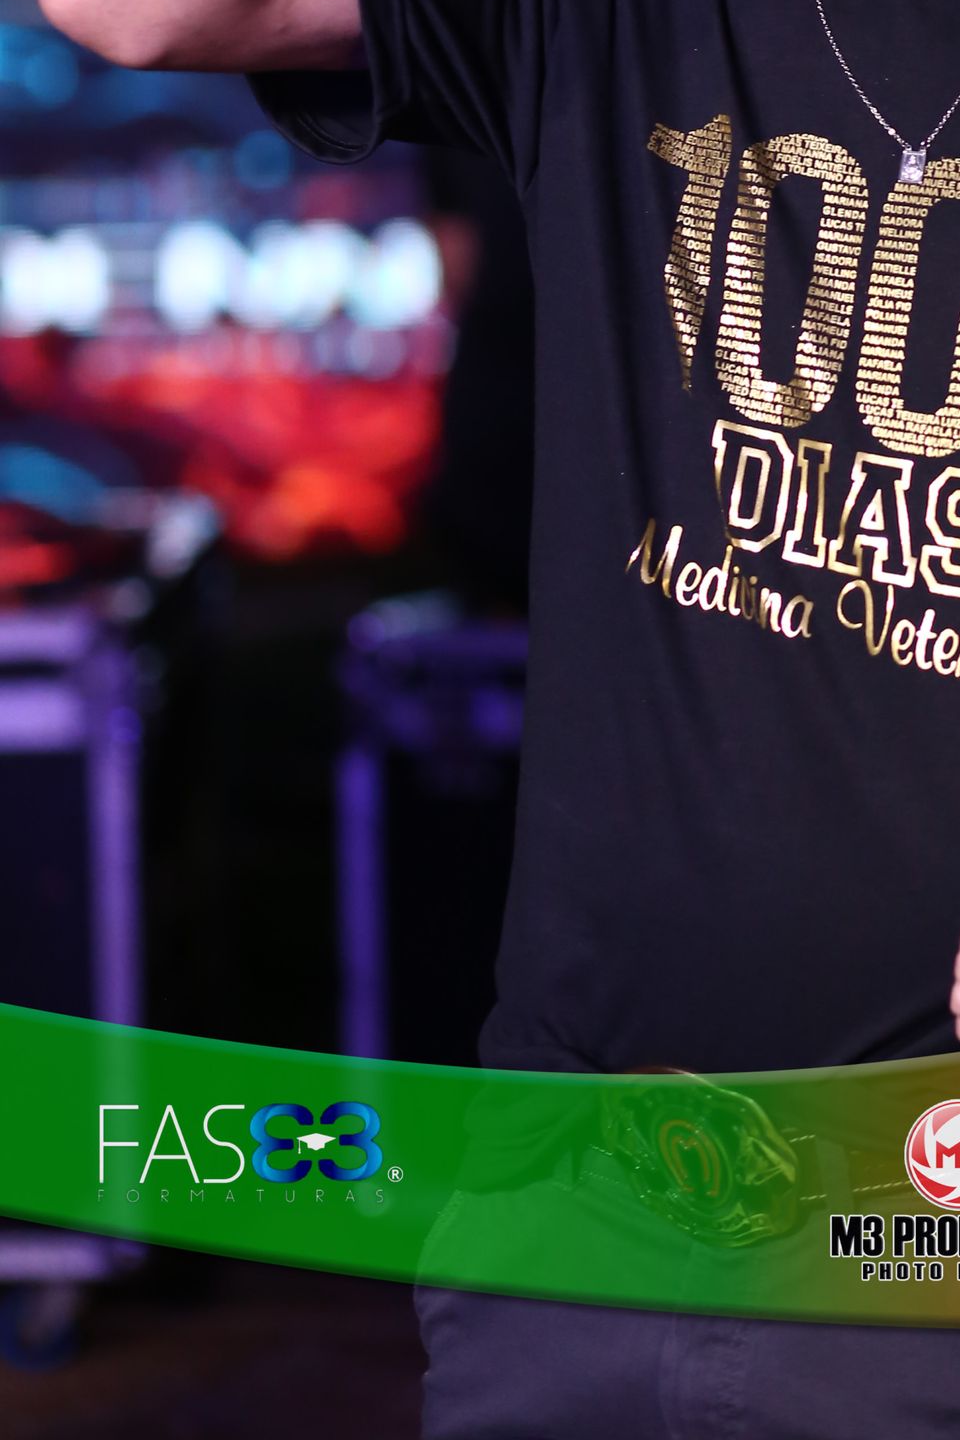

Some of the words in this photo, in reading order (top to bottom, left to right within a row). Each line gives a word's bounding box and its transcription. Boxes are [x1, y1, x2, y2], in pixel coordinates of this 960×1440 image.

[776, 153, 813, 167] FIDELIS
[814, 160, 861, 176] NATIELLE
[834, 155, 859, 166] SAN
[788, 165, 843, 182] TOLENTINO
[822, 182, 868, 197] RAFAELA
[894, 183, 938, 196] MARIANA
[824, 194, 869, 209] MARIANA
[823, 206, 866, 220] GLENDA
[883, 203, 928, 217] GUSTAVO
[820, 218, 853, 230] LUCAS
[880, 216, 923, 229] ISADORA
[879, 227, 922, 240] WELLING
[816, 241, 862, 255] GUSTAVO
[876, 239, 919, 252] AMANDA
[814, 253, 858, 267] ISADORA
[813, 264, 857, 279] WELLING
[872, 262, 917, 276] NATIELLE
[810, 276, 855, 291] AMANDA
[870, 274, 914, 288] RAFAELA
[806, 297, 853, 315] NATIELLE
[803, 308, 850, 327] RAFAELA
[715, 361, 748, 375] LUCAS
